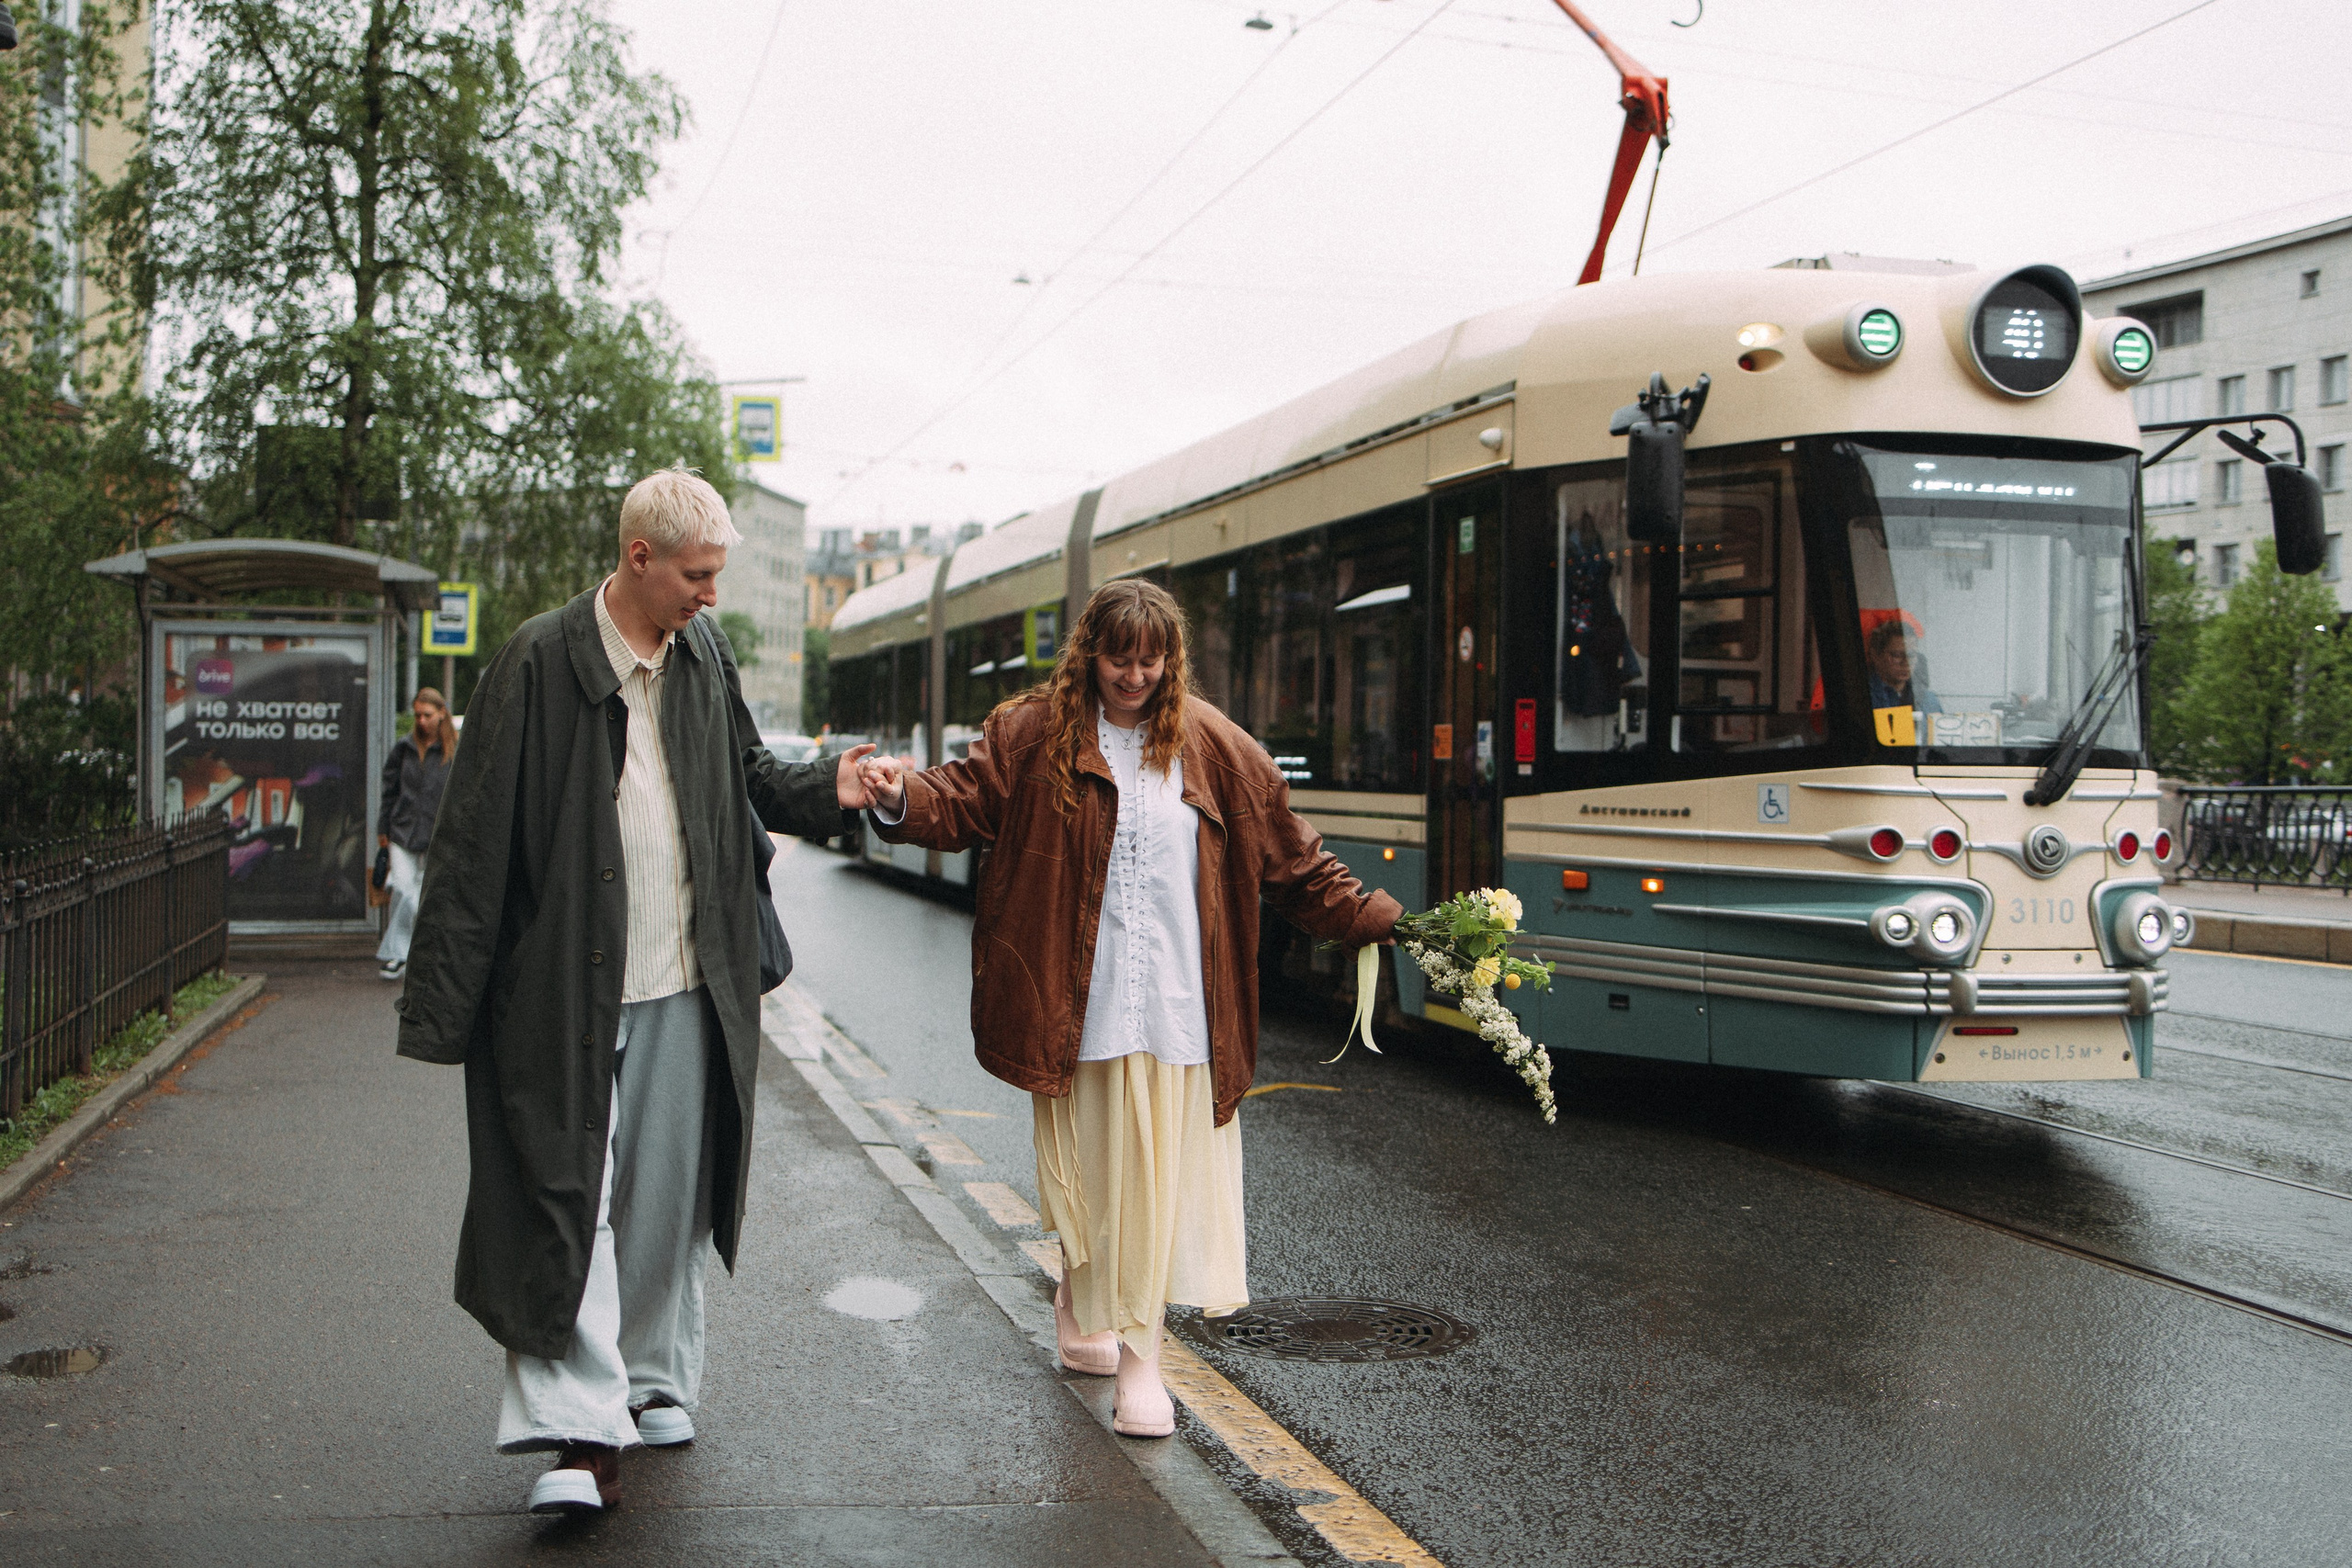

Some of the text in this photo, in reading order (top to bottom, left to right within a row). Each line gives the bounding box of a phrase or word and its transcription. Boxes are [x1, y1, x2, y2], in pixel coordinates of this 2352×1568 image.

[236, 701, 343, 720] хватает
[196, 721, 340, 740] только вас
[2009, 897, 2075, 924] 3110
[1991, 1043, 2091, 1061] Вынос 1,5 м
